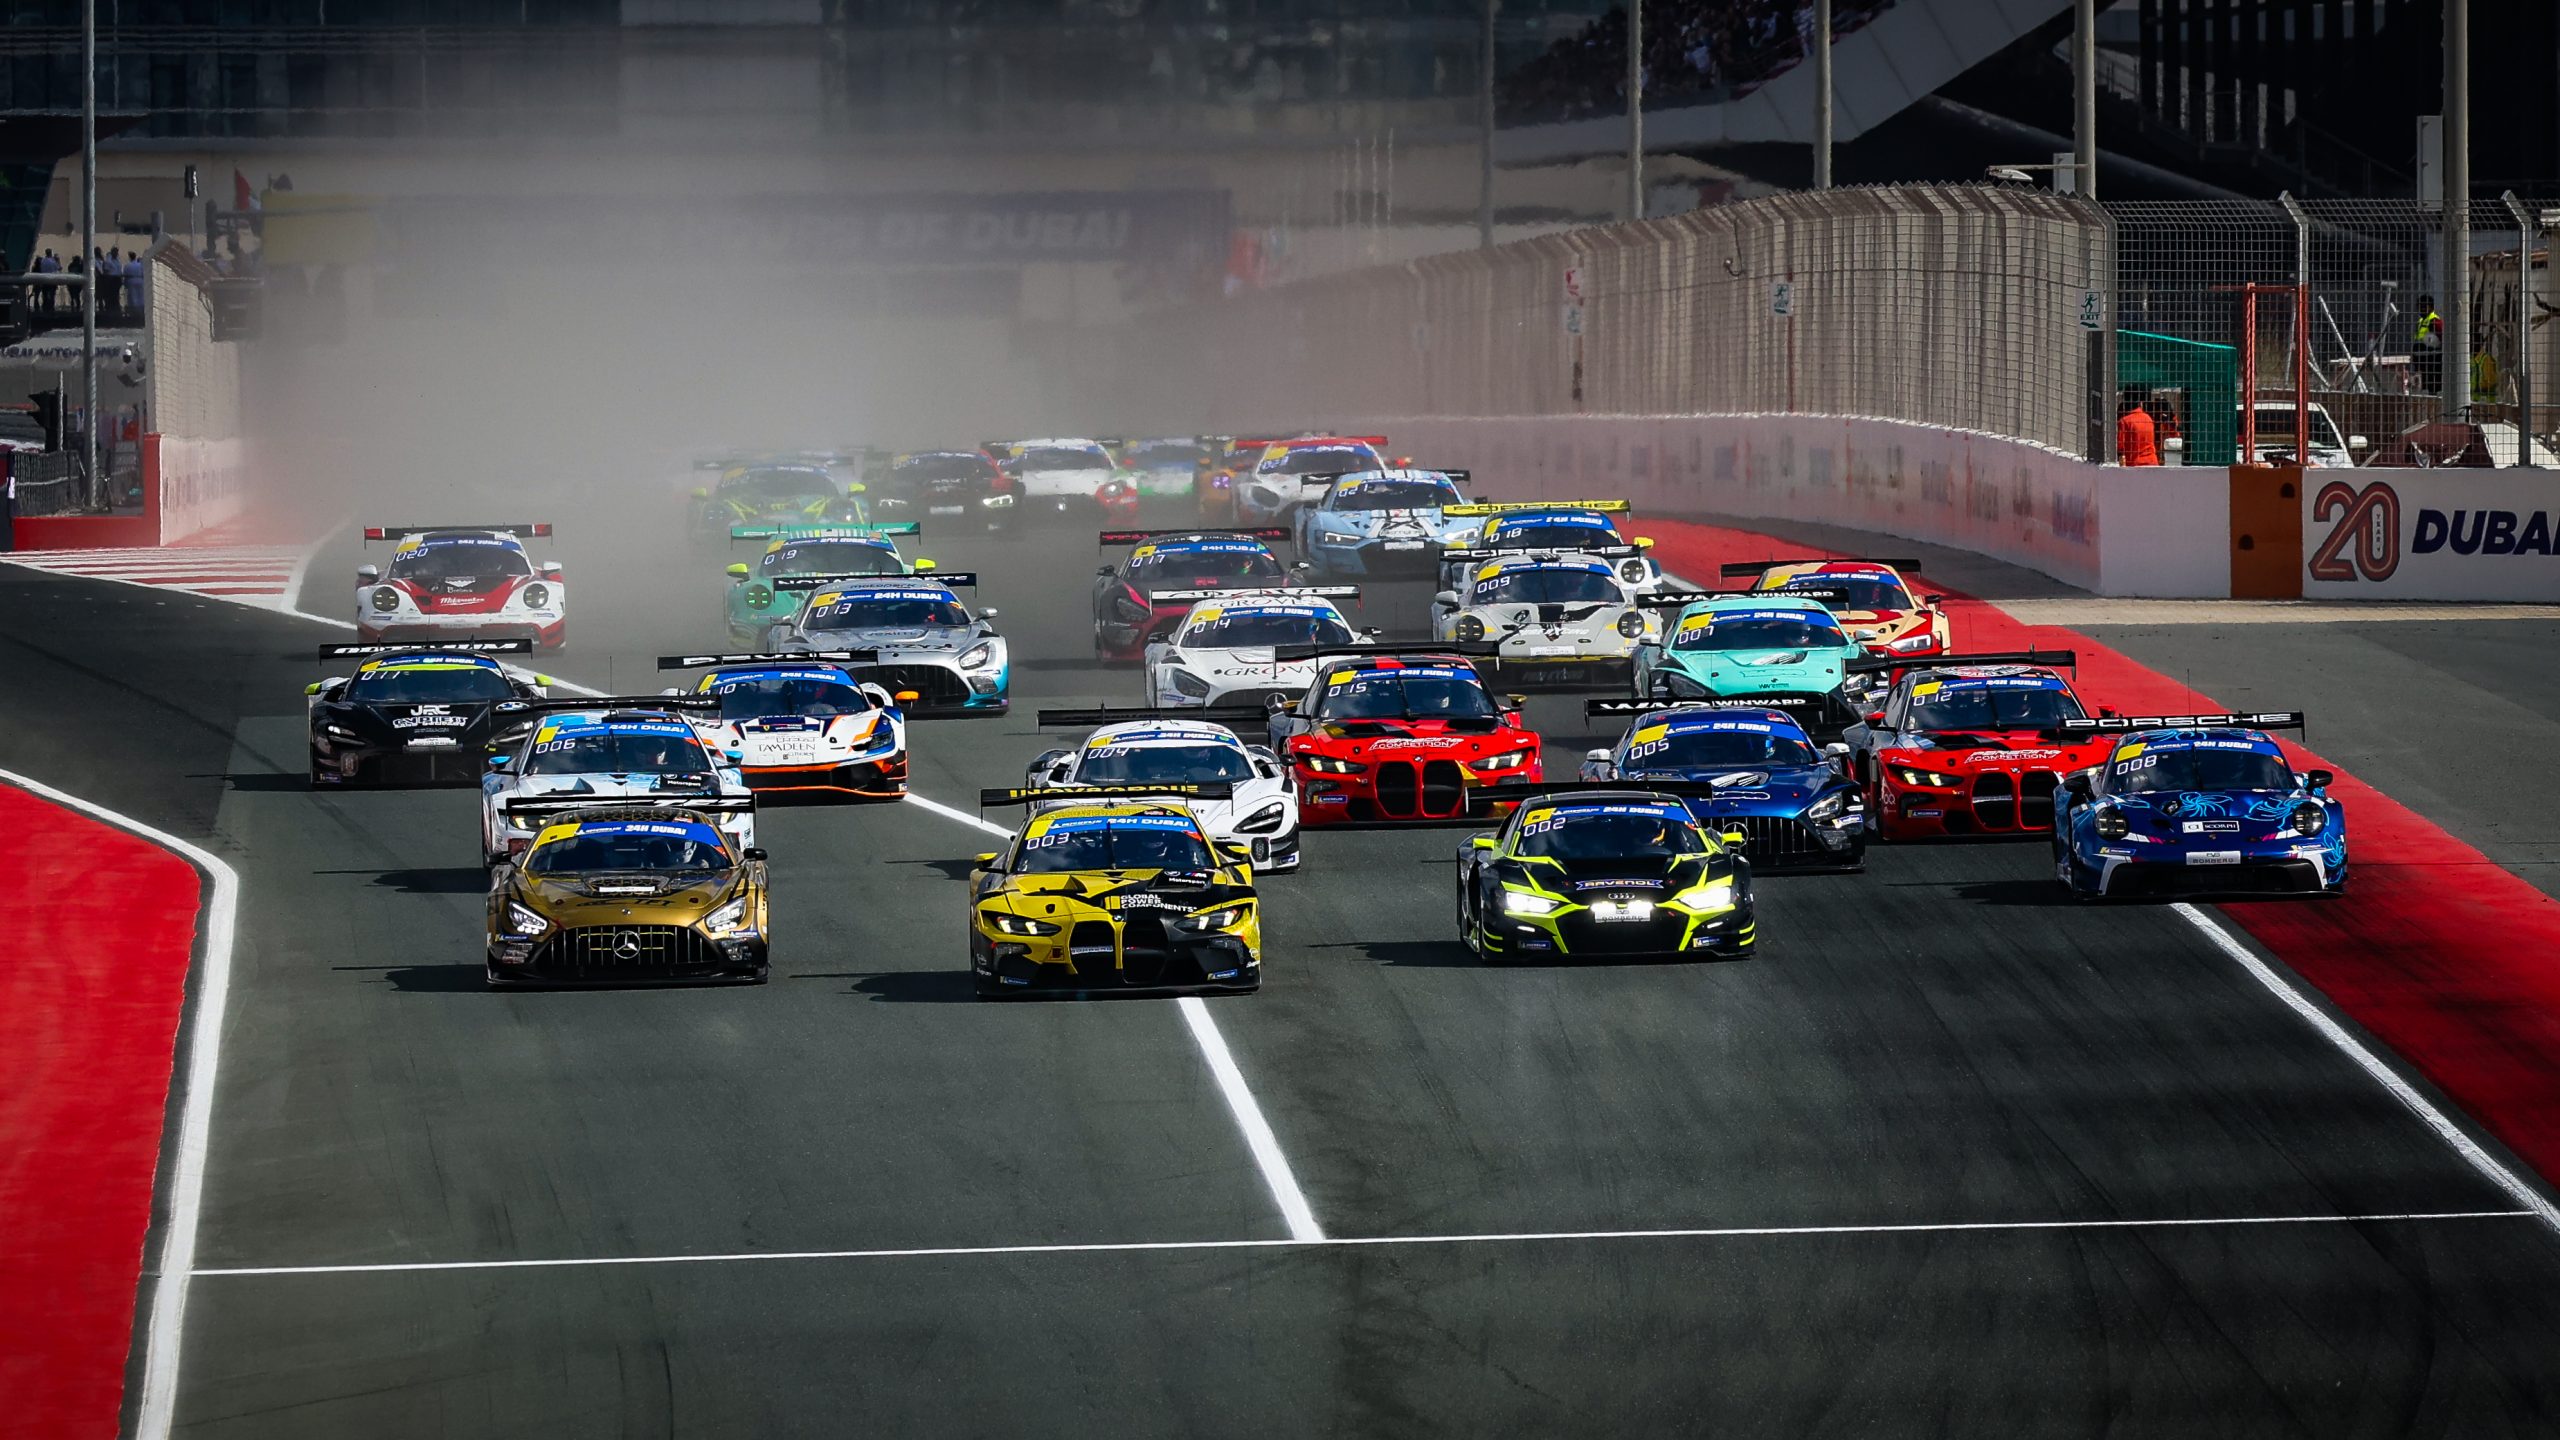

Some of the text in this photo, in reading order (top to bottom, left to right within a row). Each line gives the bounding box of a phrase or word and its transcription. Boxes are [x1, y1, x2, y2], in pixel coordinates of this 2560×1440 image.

[2308, 481, 2400, 582] 20
[396, 548, 429, 562] 020
[1443, 546, 1632, 557] PORSCHE
[1131, 554, 1166, 568] 017
[1477, 576, 1511, 594] 009
[816, 603, 852, 618] 013
[1194, 619, 1231, 633] 014
[1678, 625, 1715, 644] 007
[1328, 682, 1368, 697] 015
[1913, 691, 1953, 706] 012
[2065, 713, 2293, 728] PORSCHE
[640, 725, 685, 733] DUBAI
[536, 739, 576, 754] 006
[1088, 747, 1130, 760] 004
[1631, 738, 1670, 760] 005
[2116, 755, 2158, 775] 008
[651, 825, 687, 836] DUBAI
[1141, 819, 1190, 827] DUBAI
[1524, 817, 1566, 837] 002
[1026, 832, 1070, 851] 003
